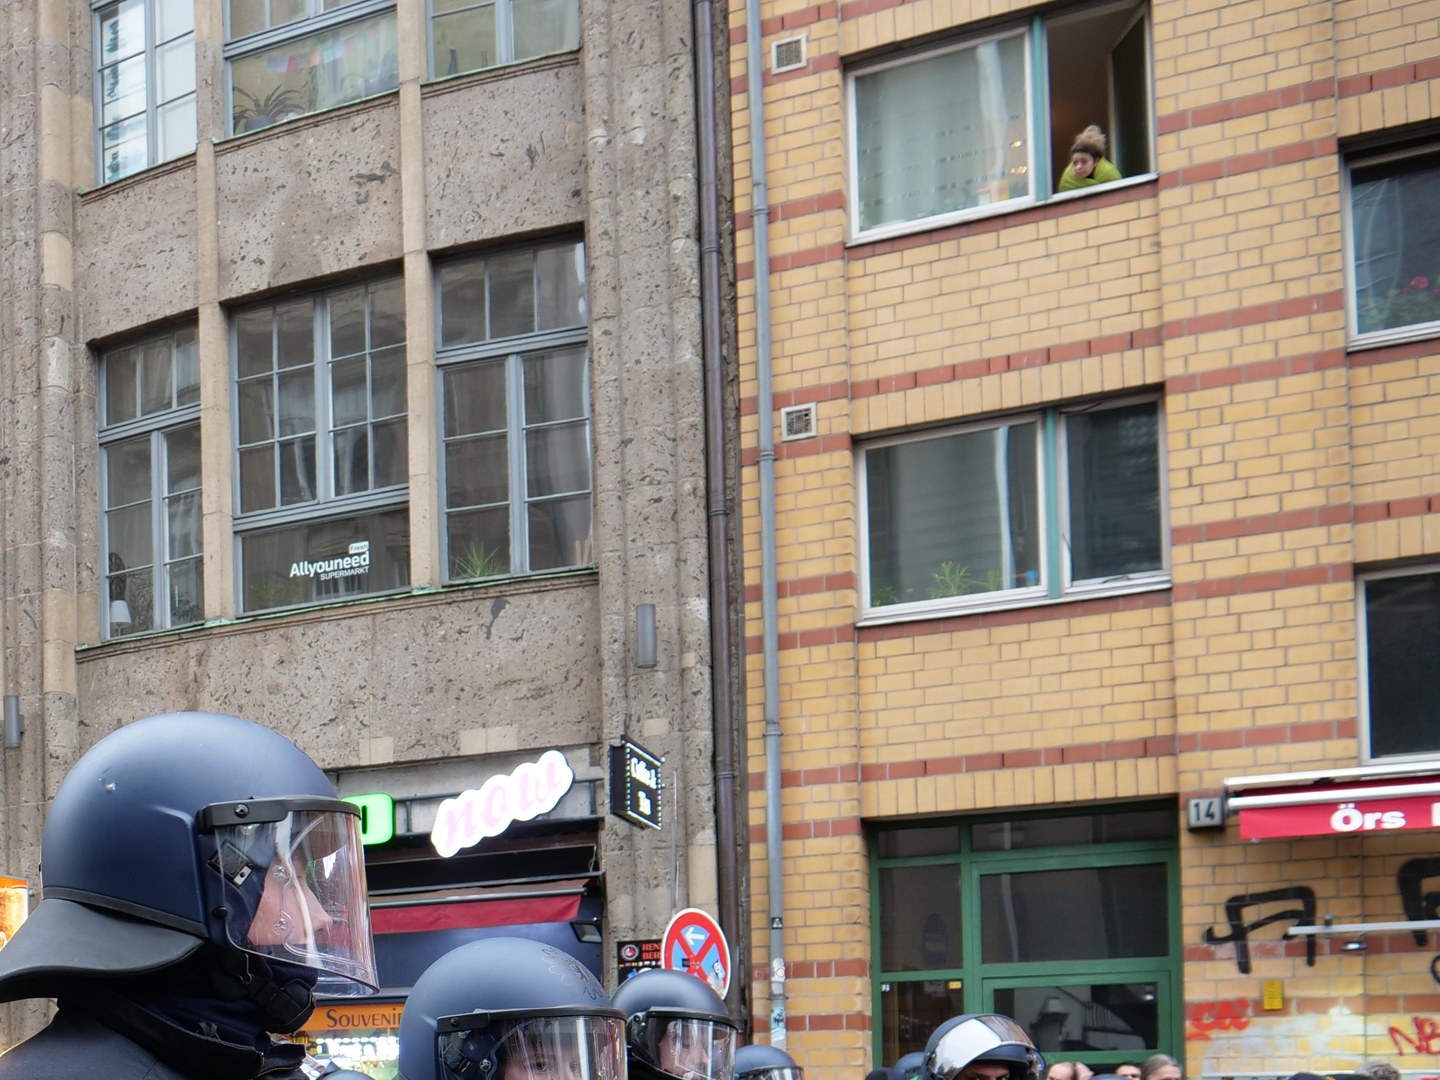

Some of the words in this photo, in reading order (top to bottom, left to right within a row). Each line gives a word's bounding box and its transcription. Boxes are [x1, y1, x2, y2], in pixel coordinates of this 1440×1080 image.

[289, 551, 369, 578] Allyouneed
[320, 566, 369, 580] SUPERMARKT
[1193, 801, 1216, 822] 14
[1330, 803, 1406, 832] Örs
